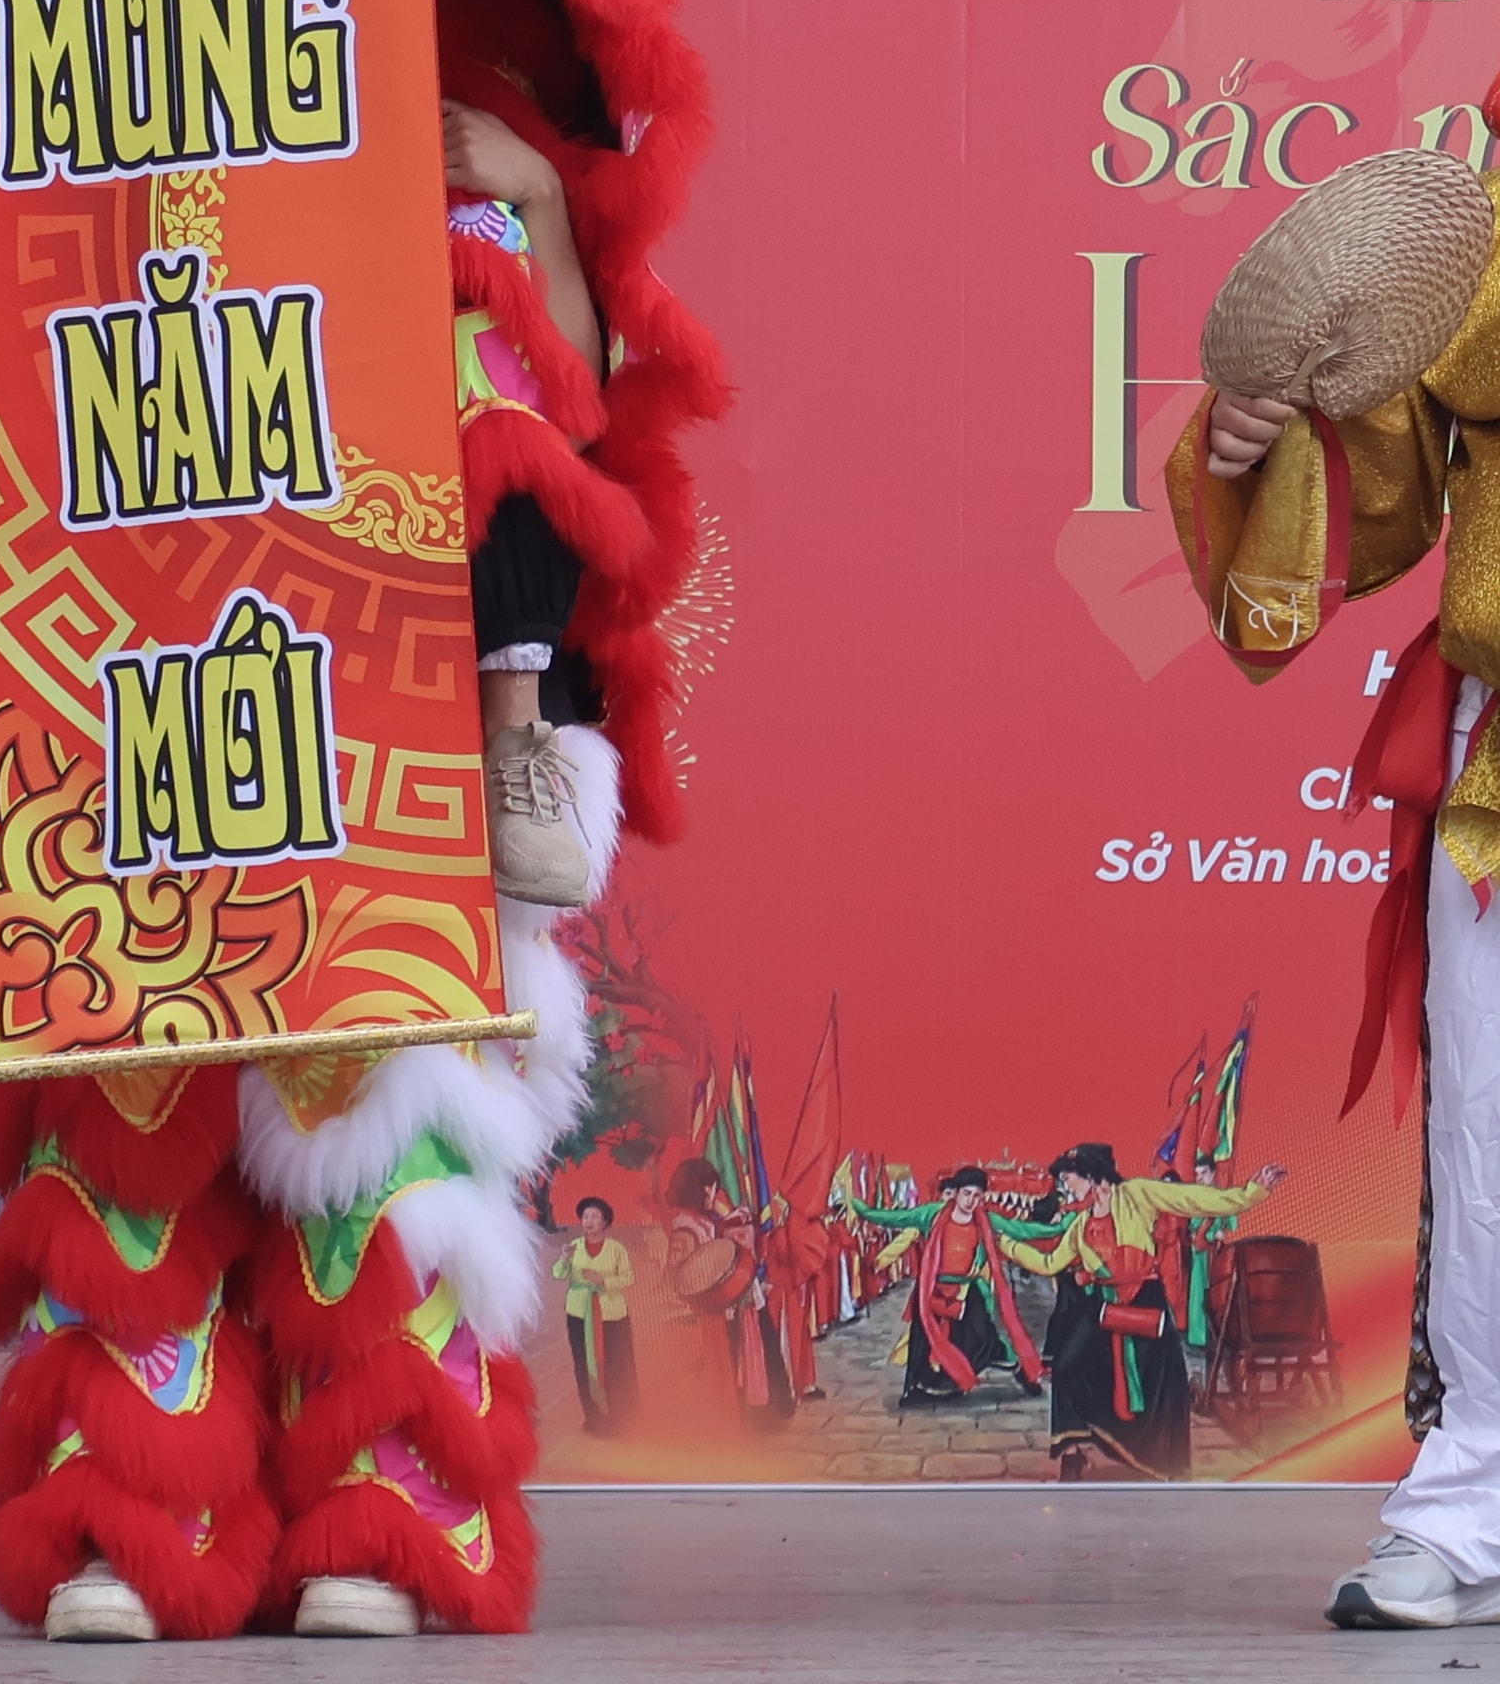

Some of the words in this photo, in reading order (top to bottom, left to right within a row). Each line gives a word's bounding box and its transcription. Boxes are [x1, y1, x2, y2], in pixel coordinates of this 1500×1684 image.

[54, 254, 333, 523] NĂM
[104, 594, 338, 869] MỚI
[1095, 830, 1173, 883] Sở
[1187, 836, 1288, 883] Văn
